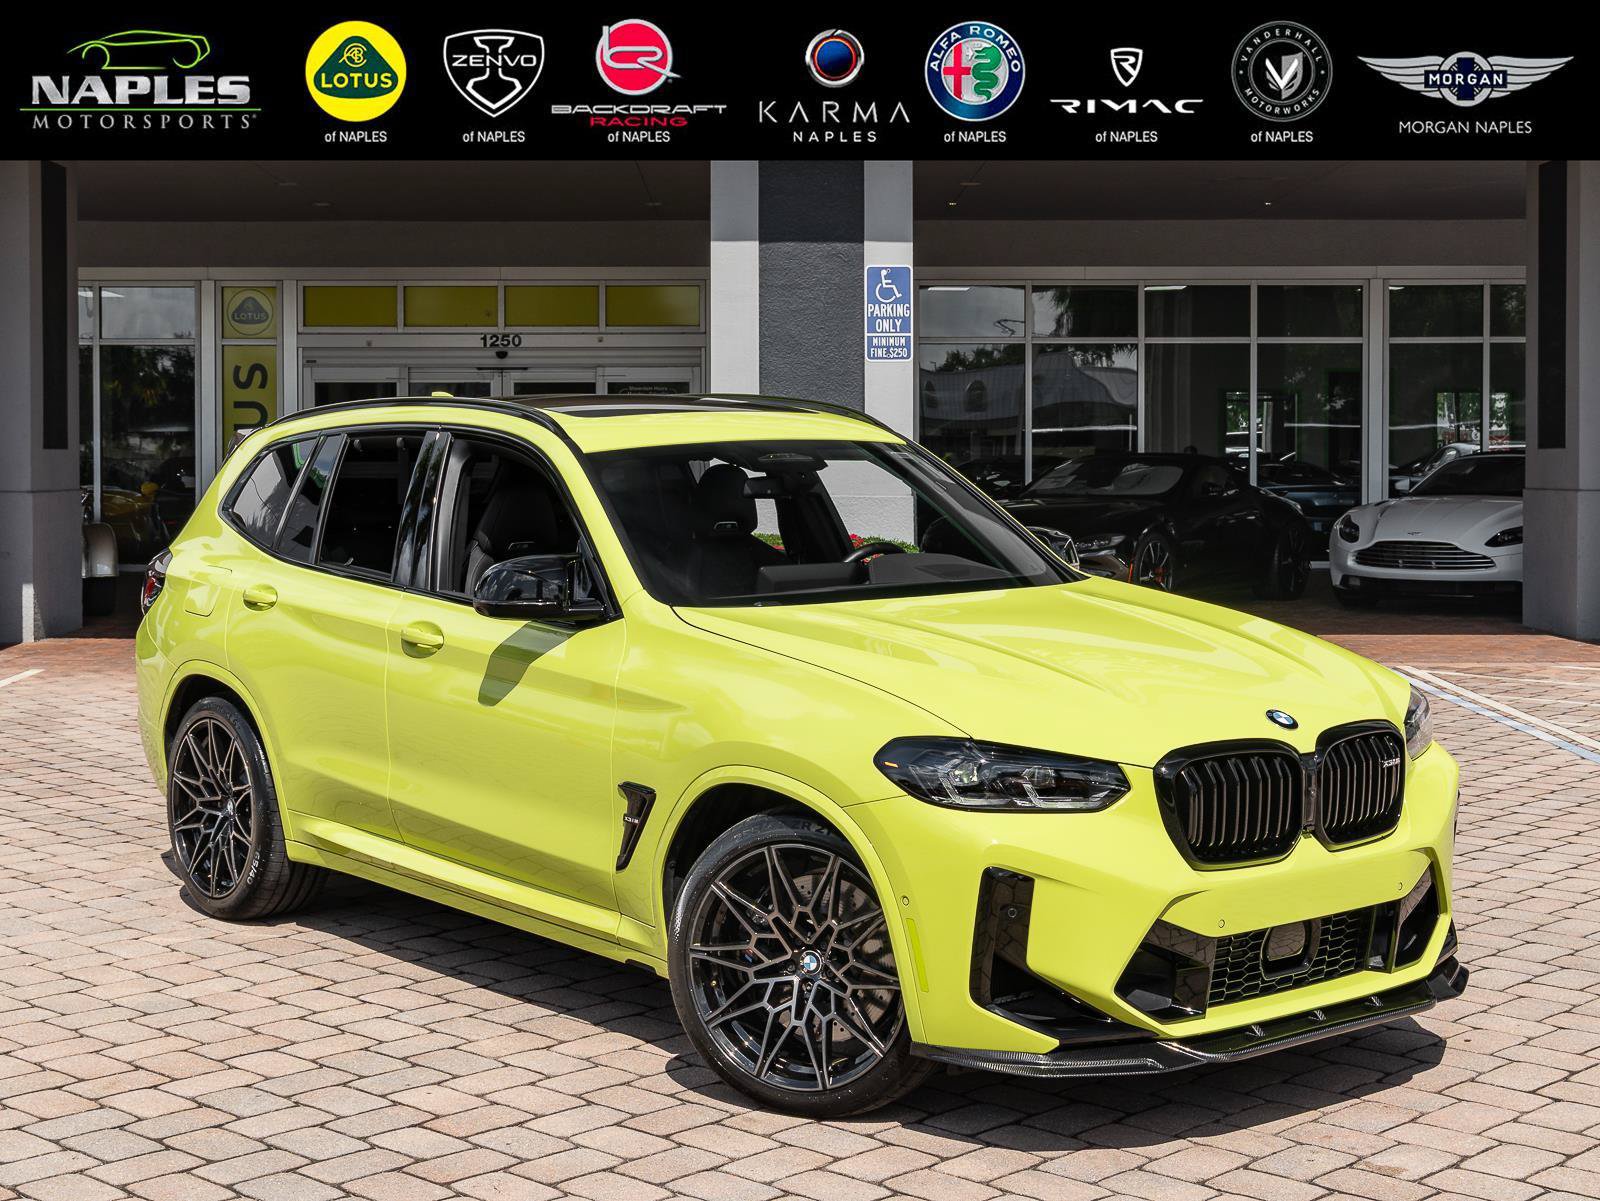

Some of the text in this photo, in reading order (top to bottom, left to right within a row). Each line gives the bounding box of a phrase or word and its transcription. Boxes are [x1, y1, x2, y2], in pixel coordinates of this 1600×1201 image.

[234, 311, 267, 321] LOTUS
[867, 303, 910, 318] PARKING
[875, 318, 903, 333] ONLY
[480, 332, 522, 348] 1250
[872, 337, 906, 347] MINIMUM
[870, 347, 908, 358] FINE $250
